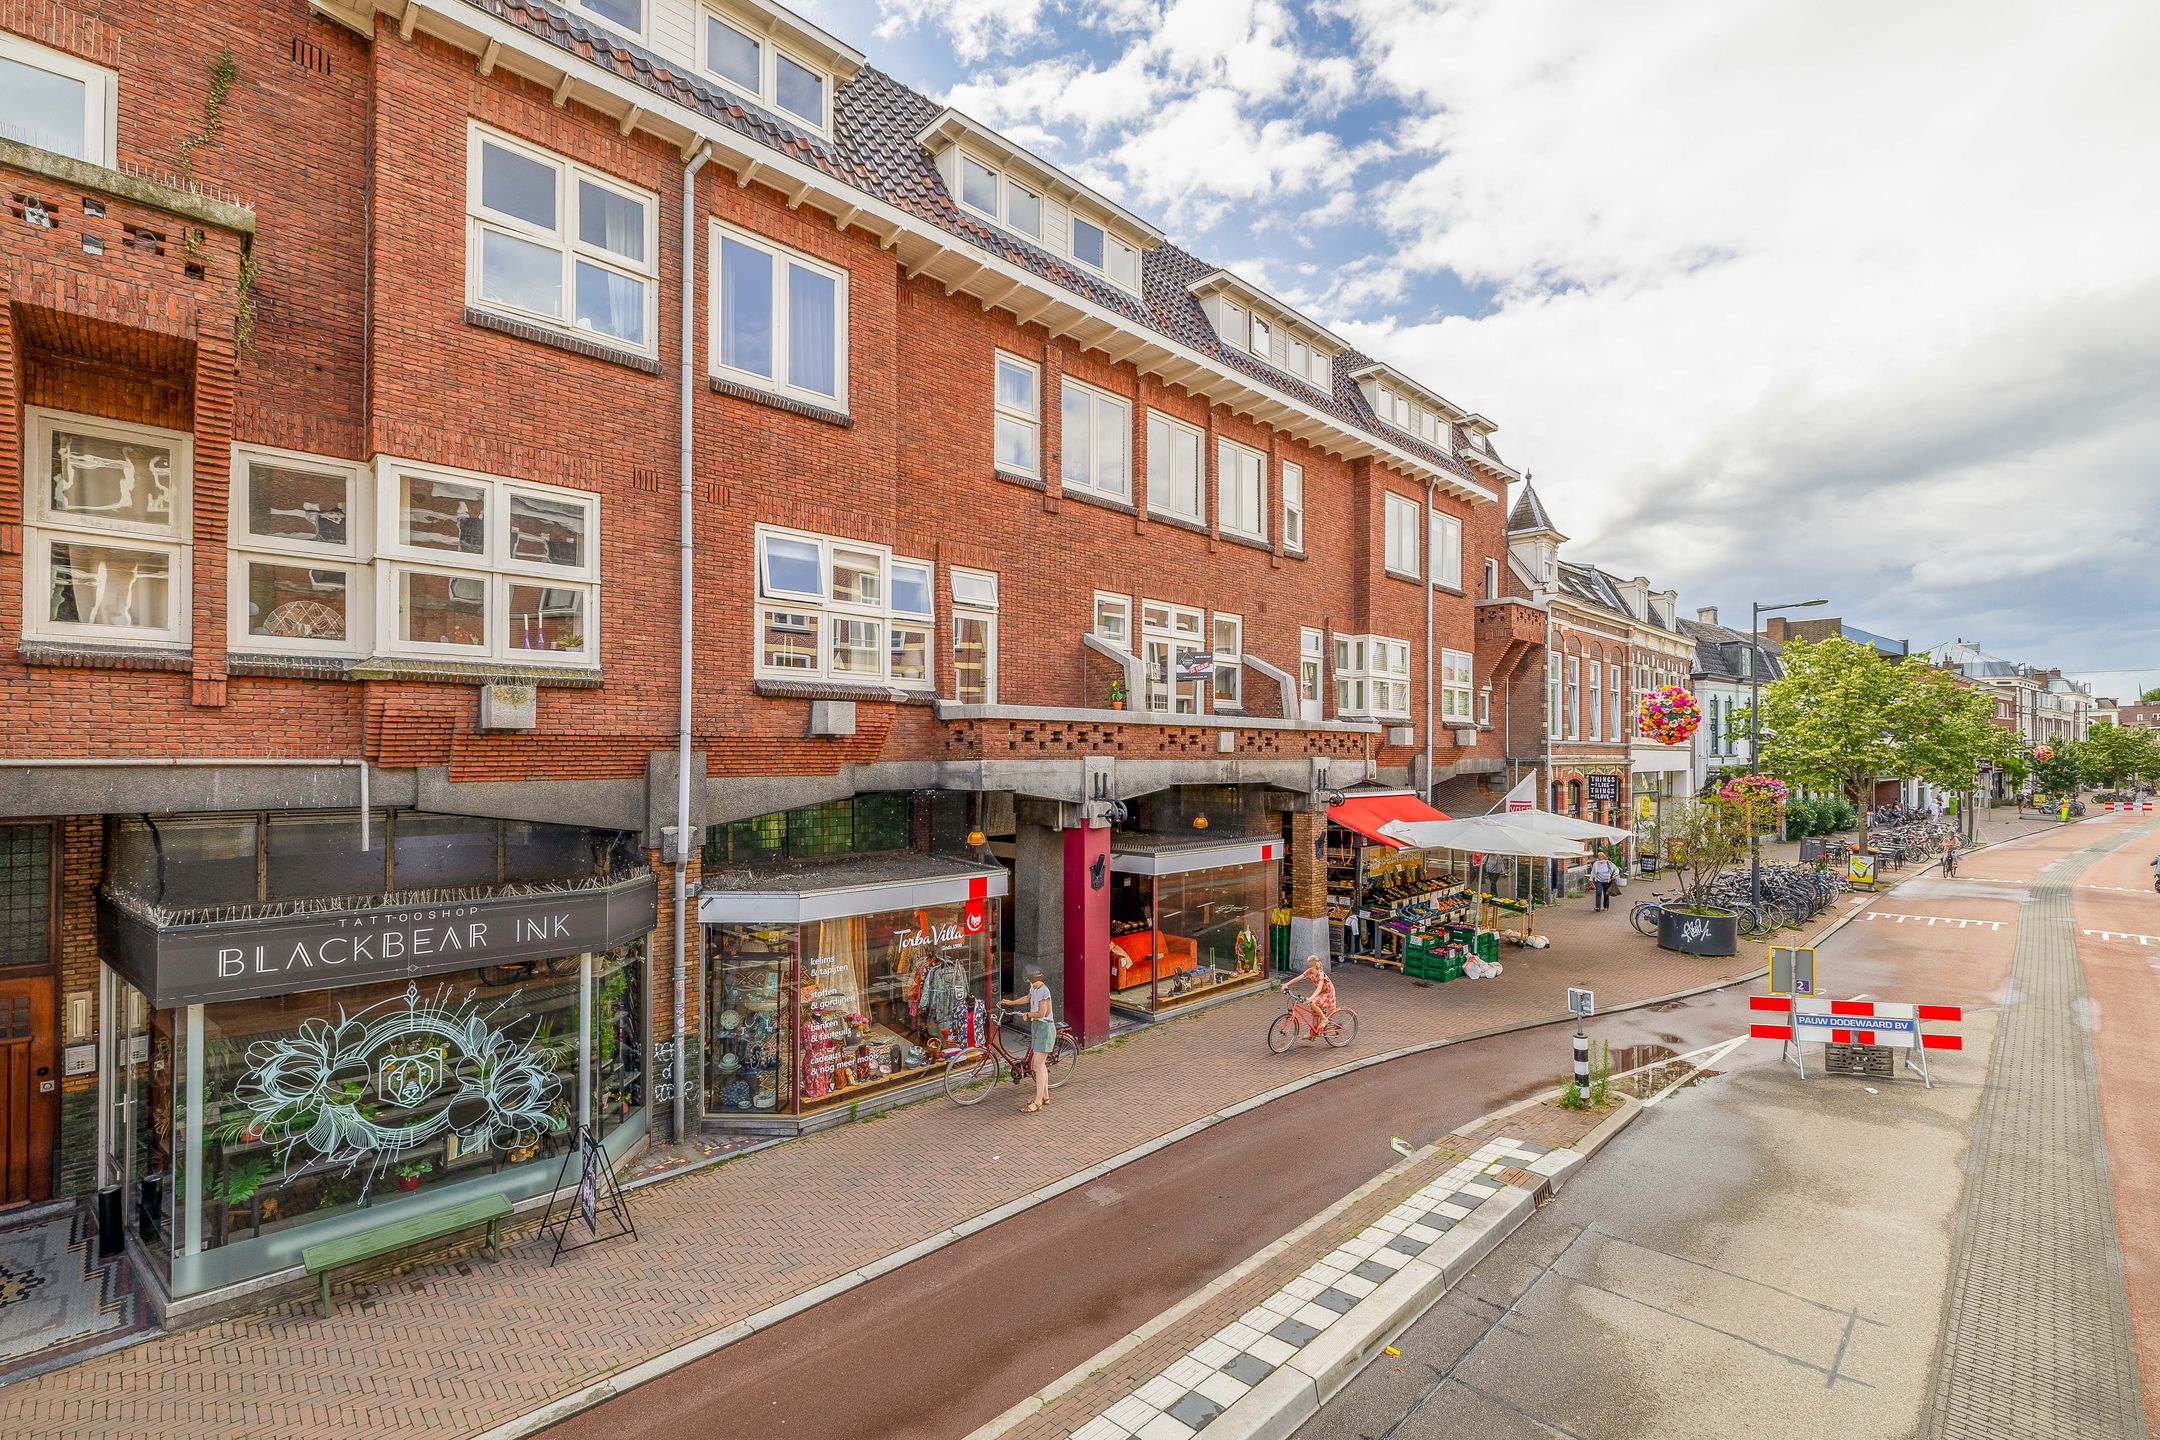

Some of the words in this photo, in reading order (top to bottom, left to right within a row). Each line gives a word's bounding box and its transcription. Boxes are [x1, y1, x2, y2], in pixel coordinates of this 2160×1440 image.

[338, 906, 478, 928] TATTOOSHOP
[218, 923, 488, 978] BLACKBEAR
[516, 914, 571, 943] INK
[893, 928, 933, 954] Torba
[931, 923, 965, 946] Villa
[810, 955, 835, 966] kelims
[810, 968, 818, 977] &
[820, 964, 849, 975] tapijten
[810, 987, 838, 999] stoffen
[810, 1001, 818, 1010] &
[819, 995, 856, 1010] gordijnen
[810, 1020, 839, 1032] banken
[1798, 1016, 1828, 1025] PAUW
[1830, 1018, 1893, 1029] DODEWAARD
[1894, 1021, 1909, 1030] BV
[810, 1034, 818, 1043] &
[819, 1026, 852, 1041] fauteuils
[810, 1067, 818, 1076] &
[819, 1064, 835, 1076] nog
[836, 1057, 856, 1069] meer
[857, 1051, 880, 1063] moois
